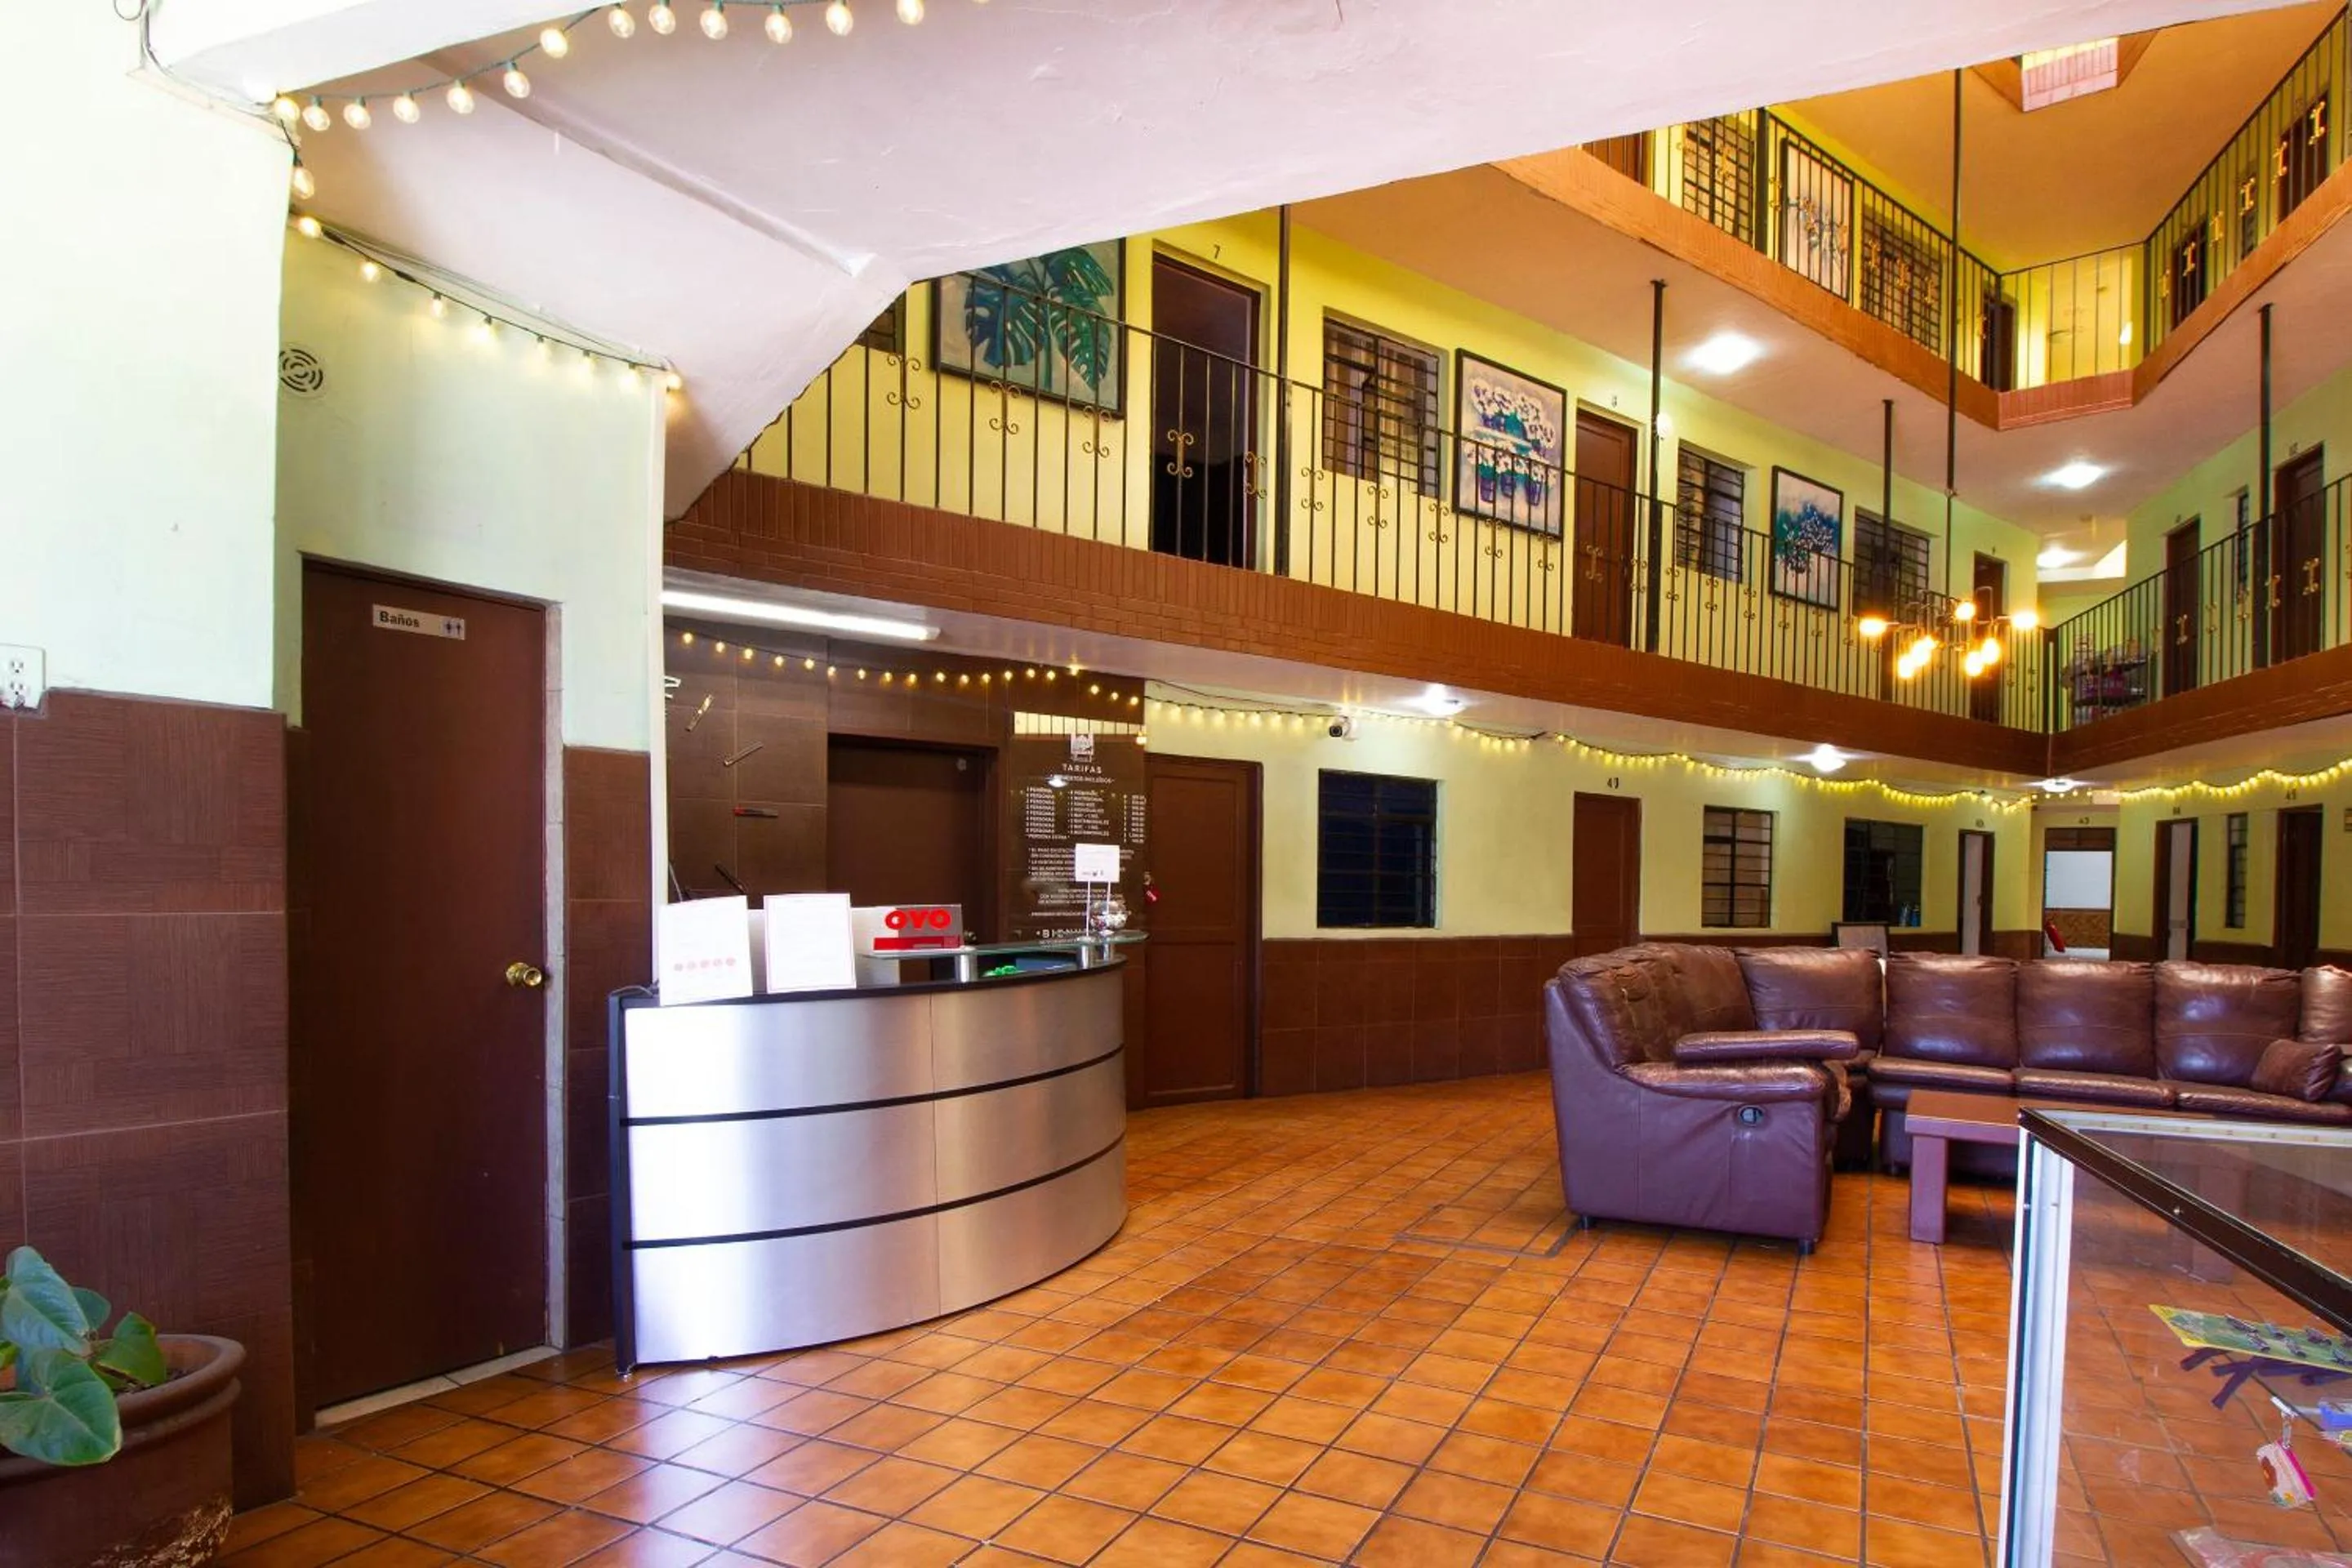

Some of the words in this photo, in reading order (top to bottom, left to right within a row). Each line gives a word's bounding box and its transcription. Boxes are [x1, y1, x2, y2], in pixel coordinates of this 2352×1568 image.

[1213, 243, 1221, 260] 7
[379, 611, 420, 628] Baños
[1062, 763, 1102, 774] TARIFAS
